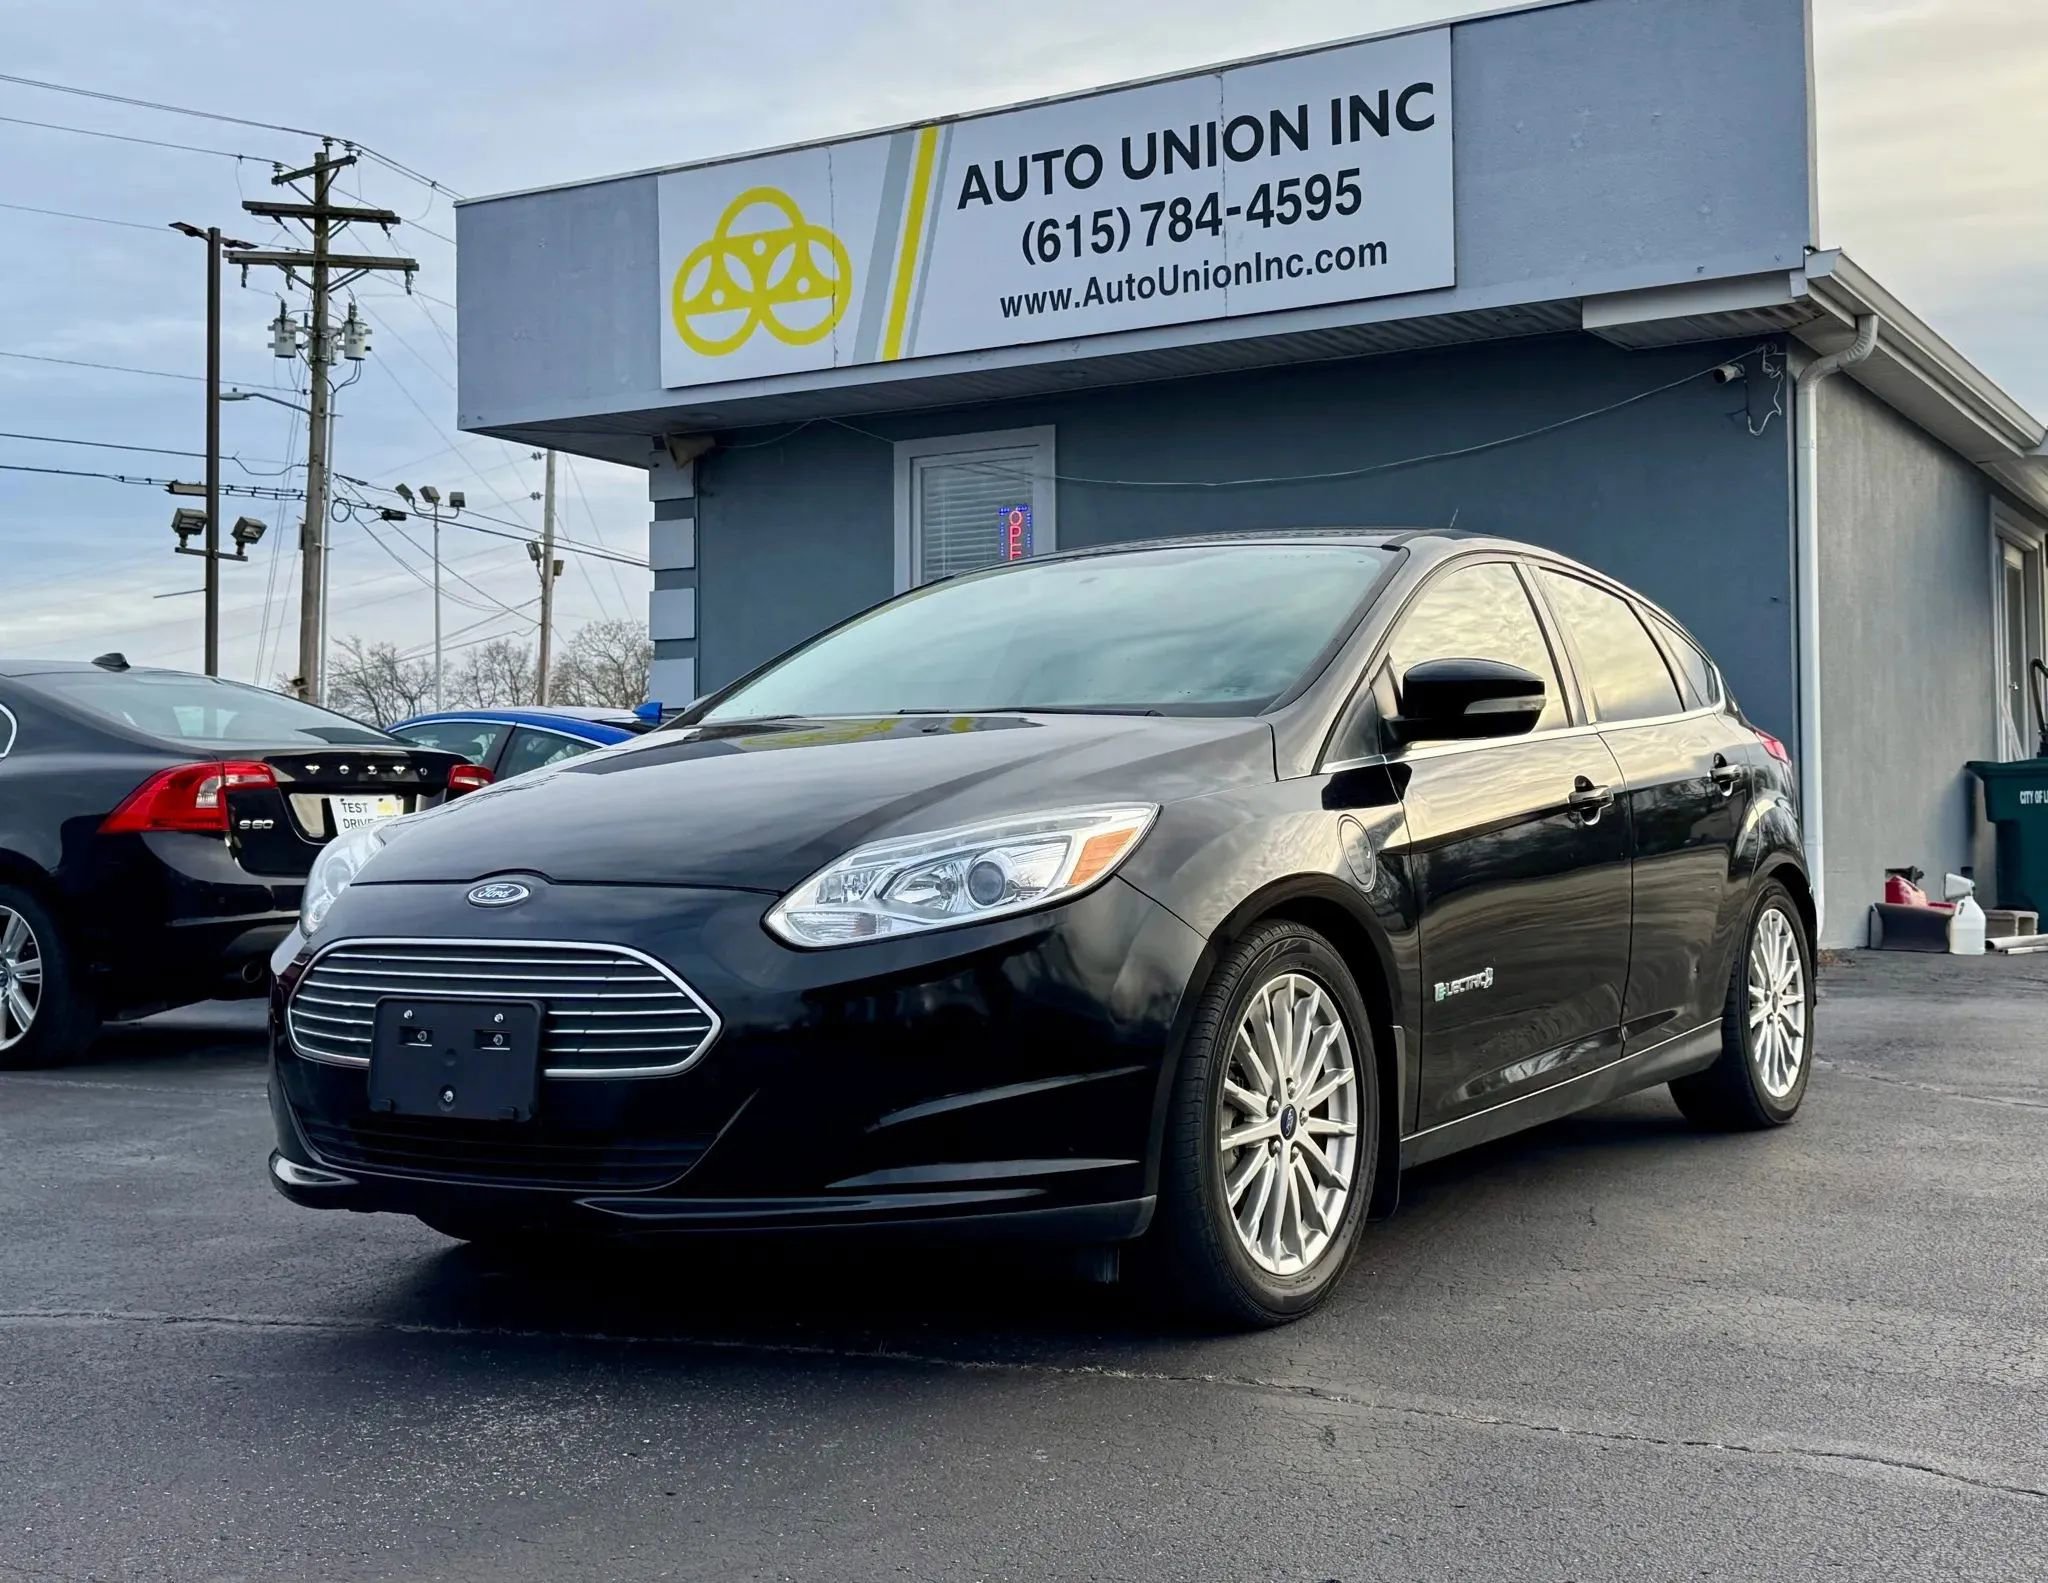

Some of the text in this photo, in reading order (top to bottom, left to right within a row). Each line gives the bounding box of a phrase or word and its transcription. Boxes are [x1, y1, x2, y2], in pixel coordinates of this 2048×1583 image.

[957, 82, 1435, 210] AUTO UNION INC
[1022, 168, 1362, 265] (615) 784-4595
[1000, 240, 1388, 318] www.AutoUnionInc.com
[1008, 510, 1022, 561] OPE
[341, 802, 368, 813] TEST
